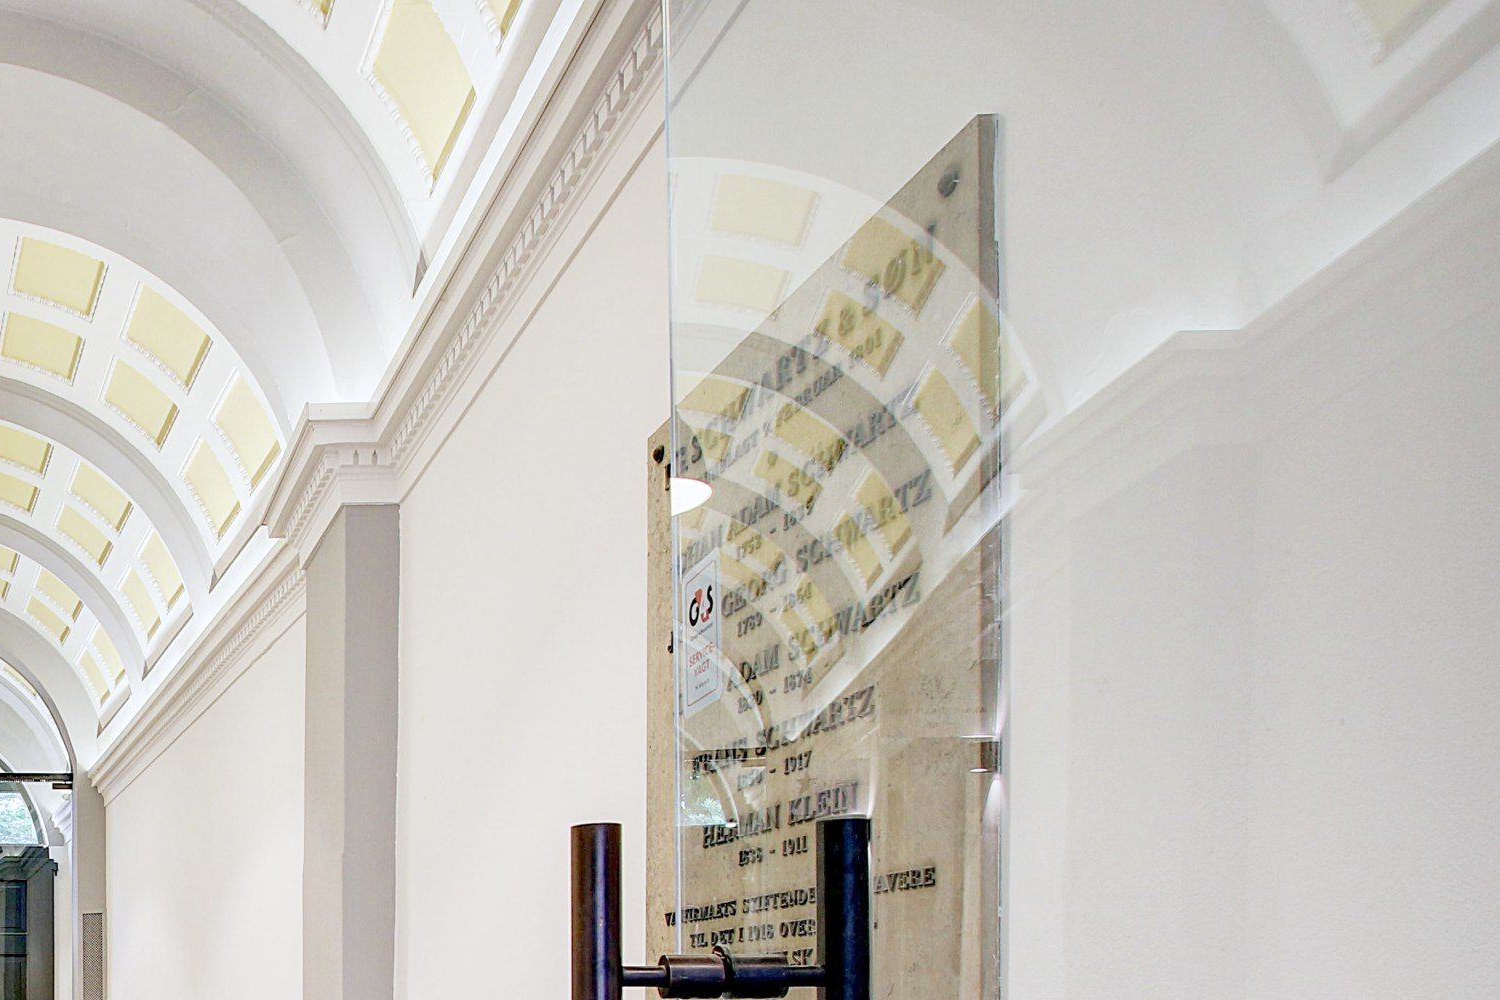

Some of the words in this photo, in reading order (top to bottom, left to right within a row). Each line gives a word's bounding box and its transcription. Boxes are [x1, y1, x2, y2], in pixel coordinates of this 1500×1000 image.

[837, 296, 854, 340] &
[721, 553, 788, 622] GEORG
[795, 463, 932, 578] SCHWARTZ
[727, 641, 779, 694] ADAM
[788, 566, 922, 665] SCHWARTZ
[755, 681, 875, 760] SCHWARTZ
[782, 747, 812, 777] 1917
[702, 802, 780, 851] HERMAN
[789, 780, 858, 826] KLEIN
[782, 834, 808, 858] 1911
[710, 927, 734, 947] DET
